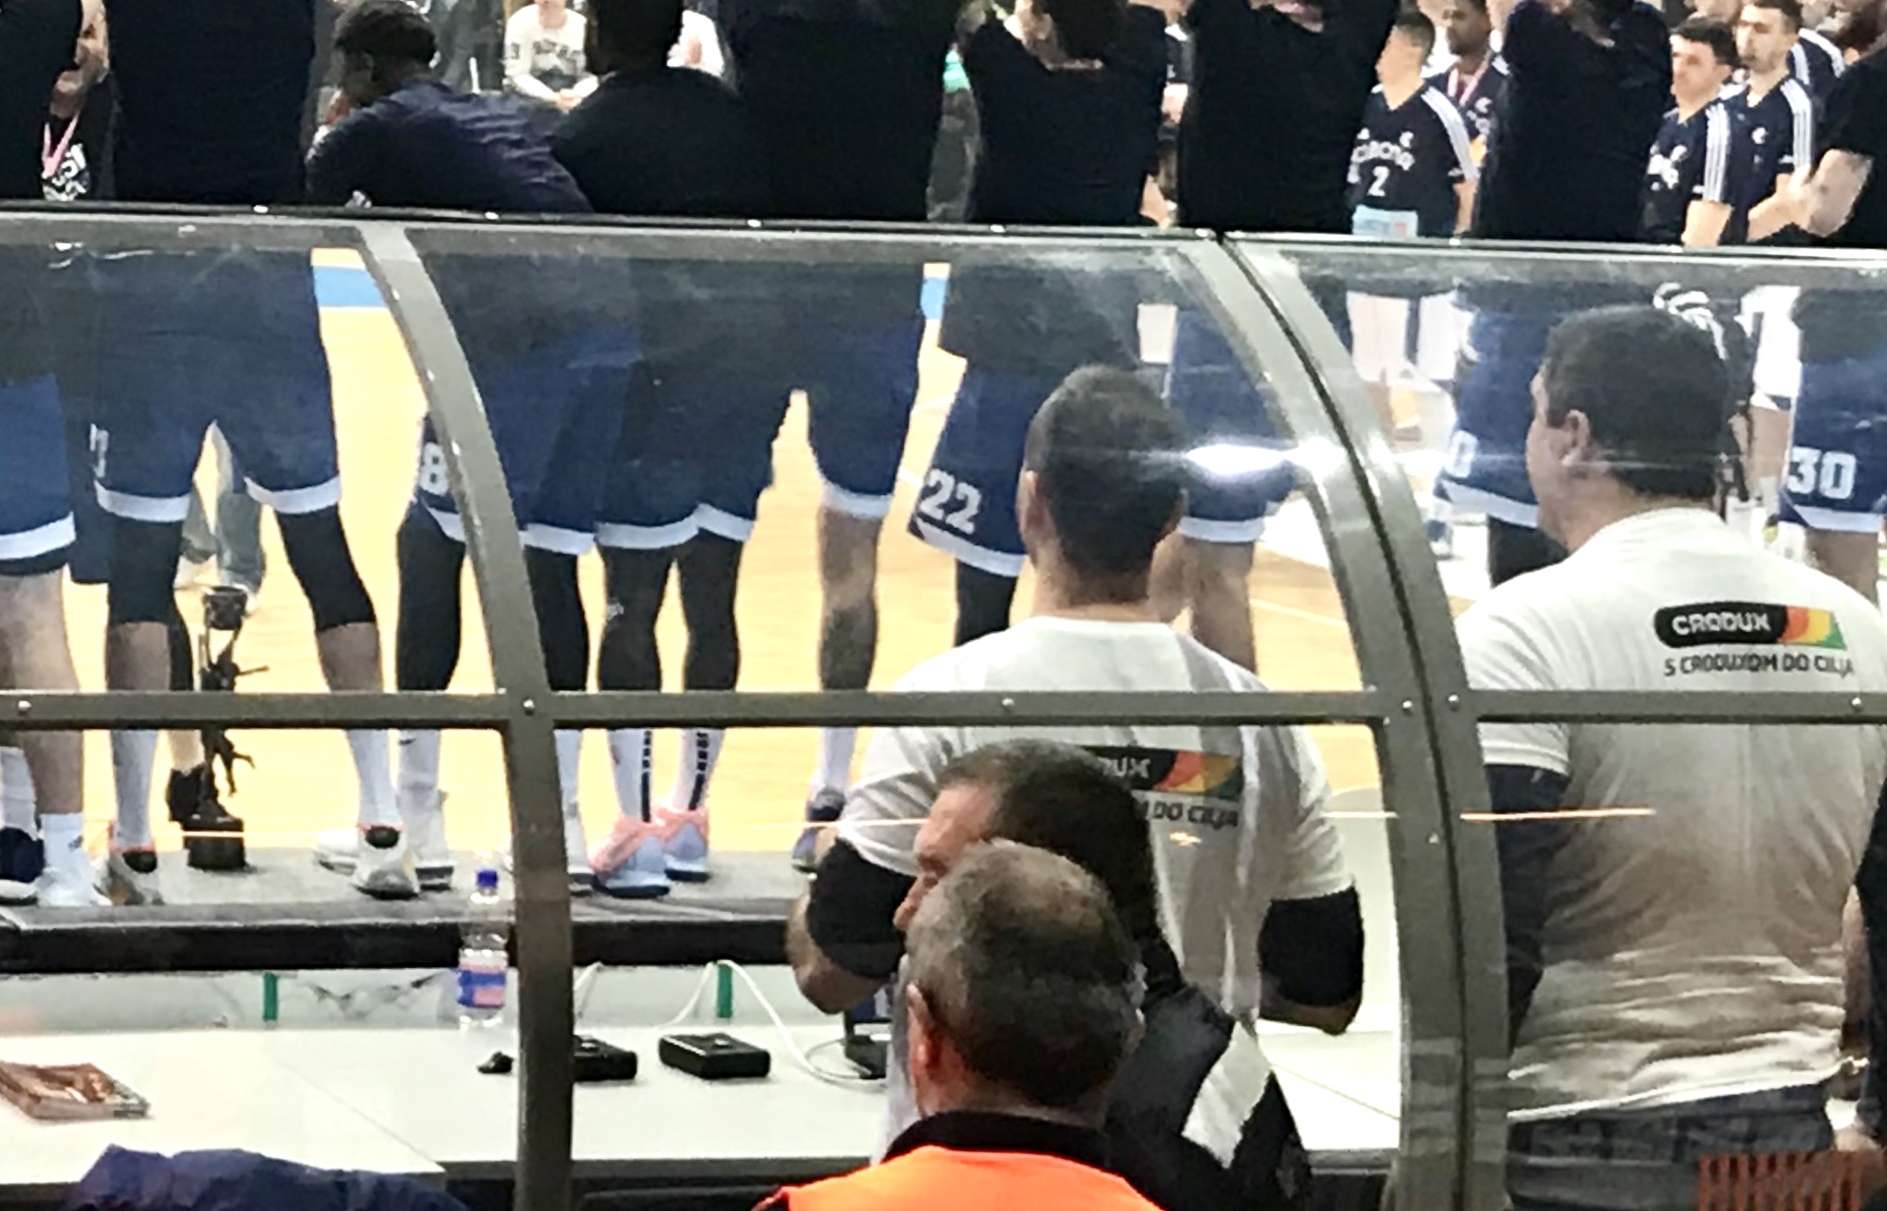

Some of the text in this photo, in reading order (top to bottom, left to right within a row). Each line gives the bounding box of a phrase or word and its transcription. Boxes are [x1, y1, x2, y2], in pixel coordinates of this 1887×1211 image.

[1367, 166, 1390, 197] 2
[1787, 446, 1857, 500] 30
[919, 469, 982, 535] 22
[1671, 611, 1772, 636] CRODUX
[1663, 657, 1676, 677] S
[1782, 655, 1810, 672] DO
[1153, 800, 1184, 821] DO
